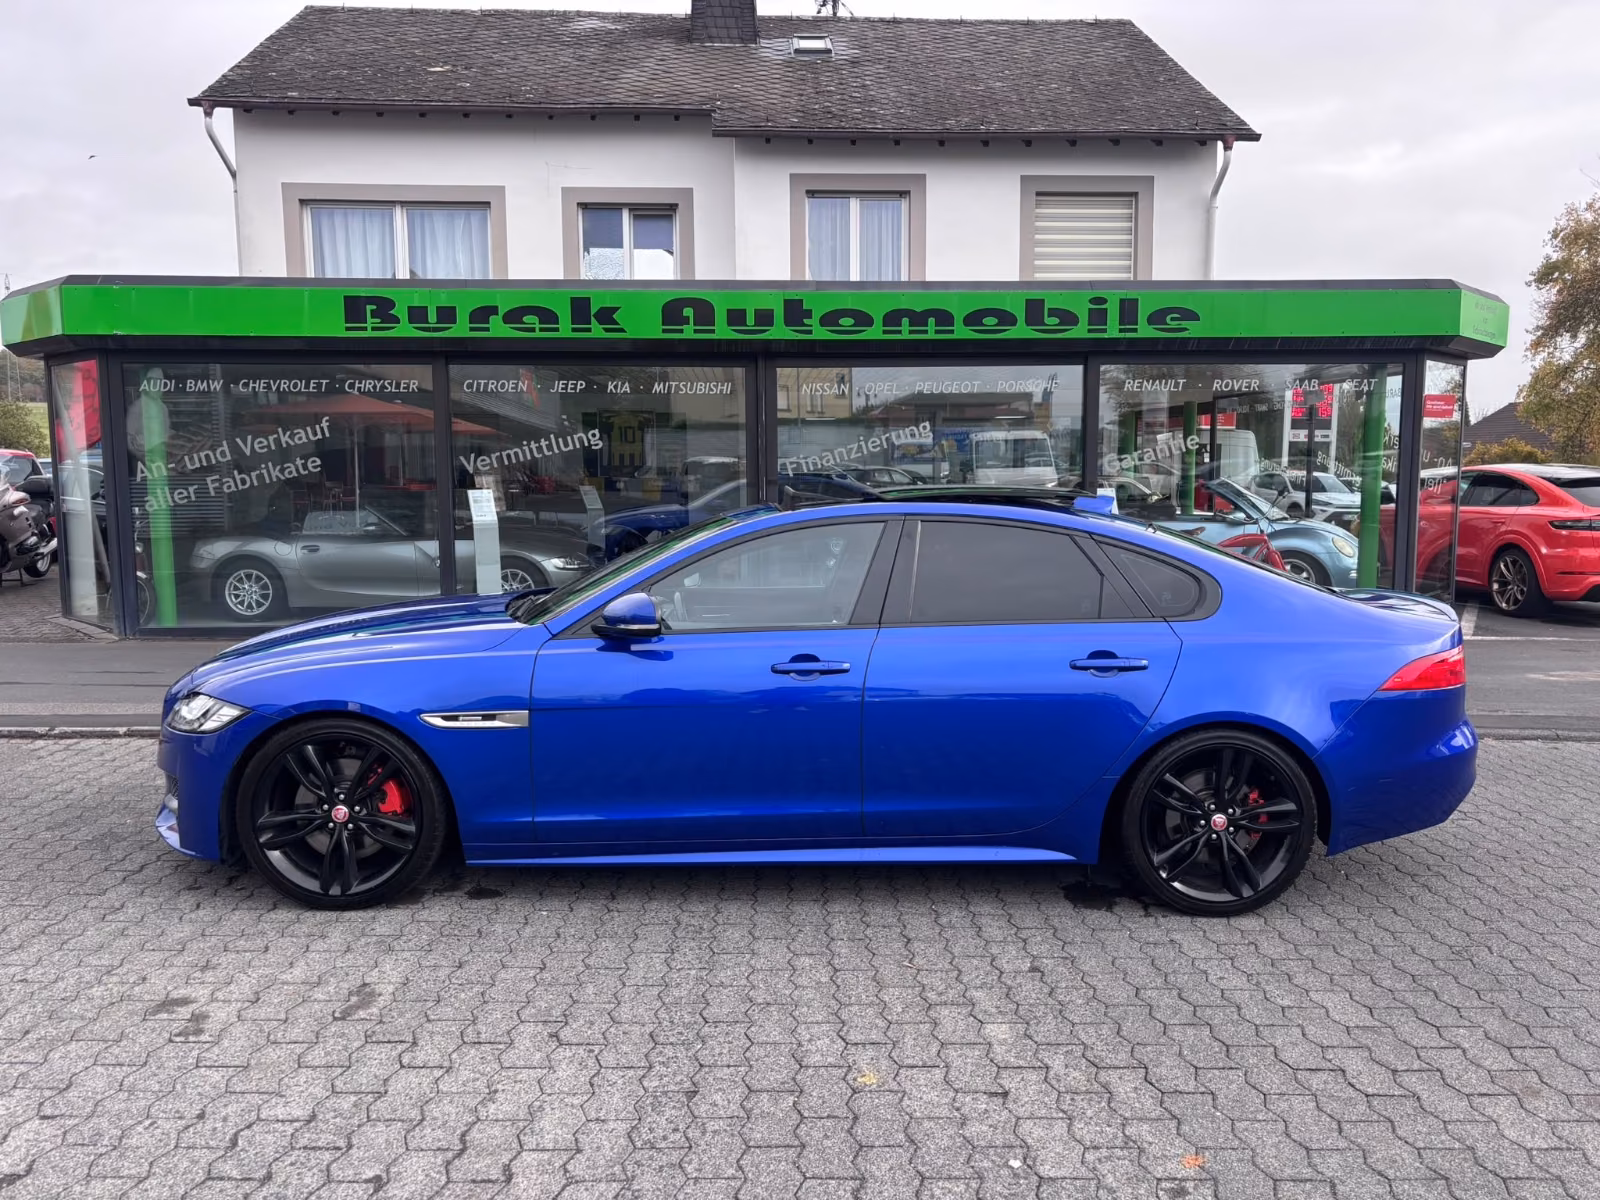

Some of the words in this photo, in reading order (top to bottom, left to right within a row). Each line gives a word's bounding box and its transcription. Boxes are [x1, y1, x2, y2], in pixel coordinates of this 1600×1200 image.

[343, 294, 628, 334] Burak
[661, 296, 1201, 336] Automobile
[139, 379, 176, 392] AUDI
[186, 379, 224, 392] BMW
[238, 379, 330, 392] CHEVROLET
[344, 379, 419, 393] CHRYSLER
[463, 379, 528, 393] CITROEN
[549, 380, 586, 393] JEEP
[606, 380, 631, 394] KIA
[652, 380, 732, 395] MITSUBISHI
[802, 382, 850, 396] NISSAN
[864, 382, 900, 395] OPEL
[914, 381, 981, 395] PEUGEOT
[996, 379, 1061, 393] PORSCHE
[1123, 379, 1186, 392] RENAULT
[1212, 379, 1260, 392] ROVER
[1285, 378, 1319, 391] SAAB
[1343, 379, 1379, 391] SEAT
[136, 460, 176, 482] An-
[184, 441, 232, 470] und
[235, 416, 331, 457] Verkauf
[459, 428, 604, 474] Vermittlung
[785, 420, 932, 477] Finanzierung
[1102, 432, 1200, 474] Garantie
[144, 484, 201, 513] aller
[206, 453, 322, 496] Fabrikate
